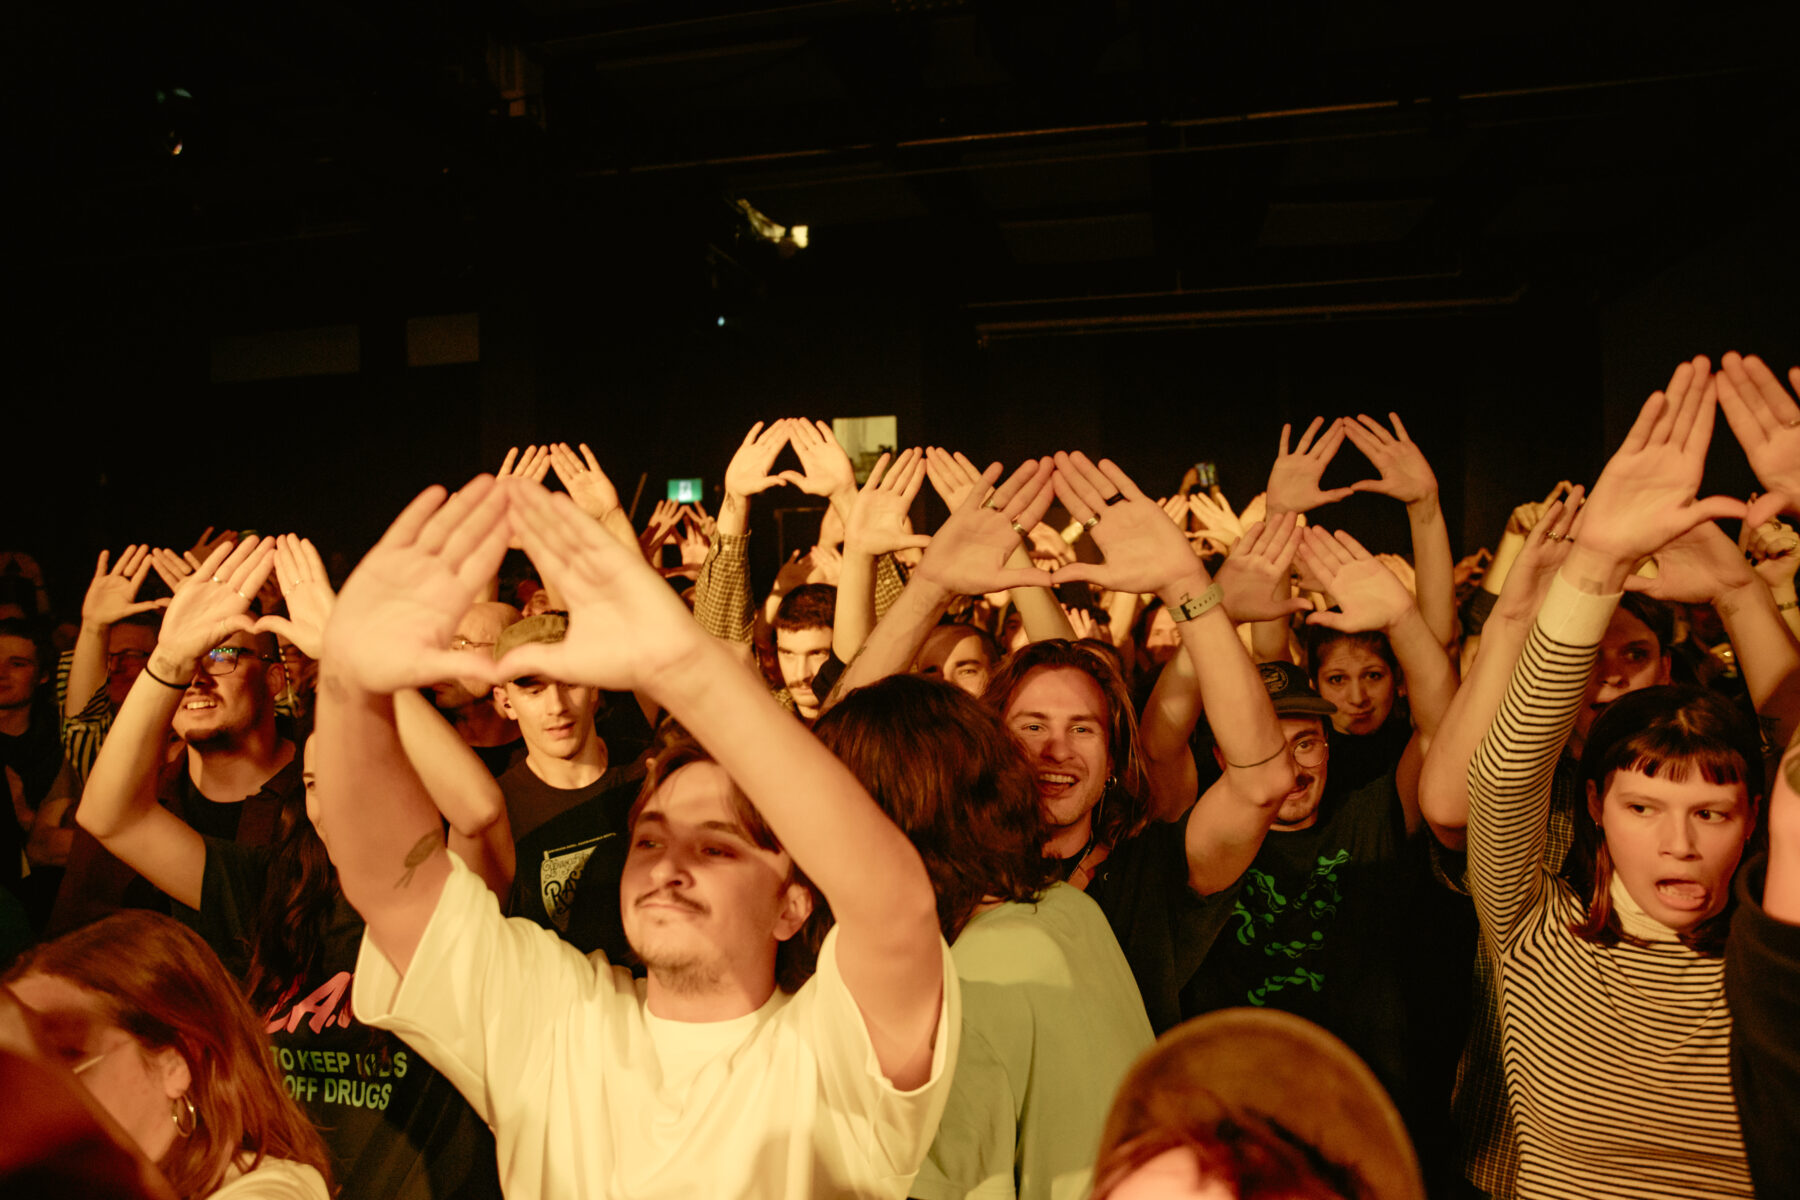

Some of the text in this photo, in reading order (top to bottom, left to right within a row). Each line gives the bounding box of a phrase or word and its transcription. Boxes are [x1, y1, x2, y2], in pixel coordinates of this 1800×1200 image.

[269, 1046, 294, 1071] TO
[297, 1049, 350, 1074] KEEP
[283, 1075, 392, 1111] OFF DRUGS
